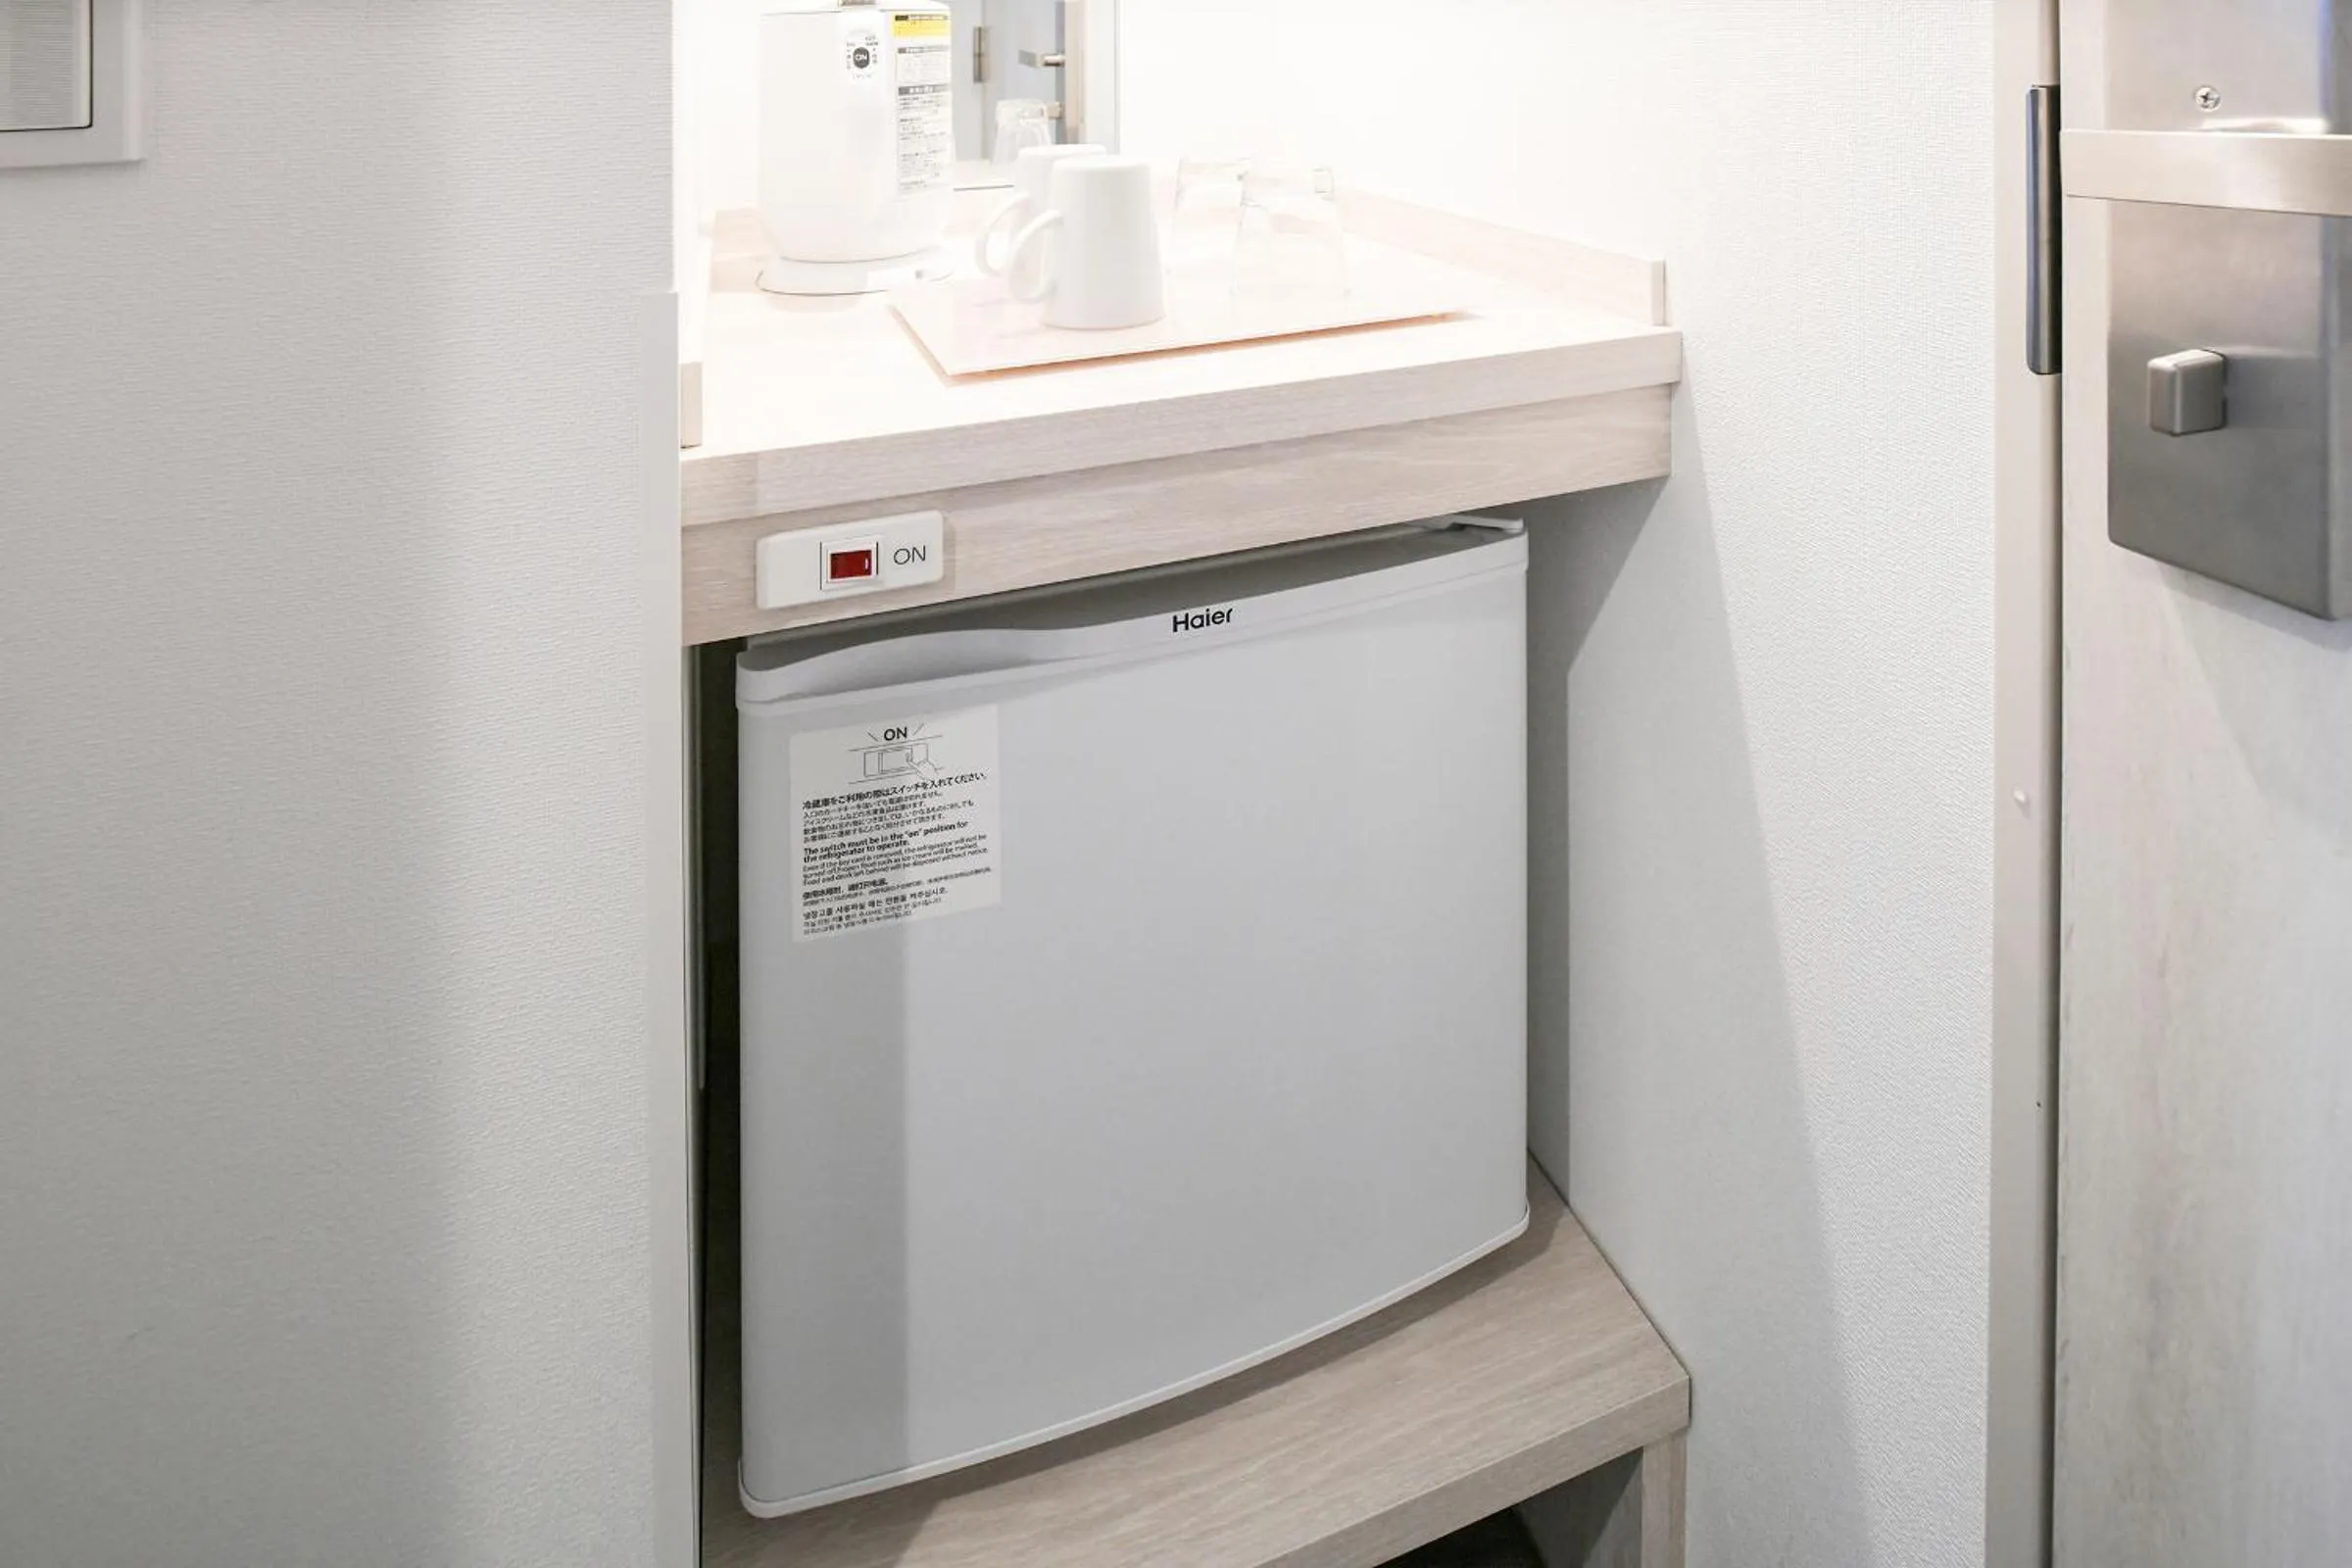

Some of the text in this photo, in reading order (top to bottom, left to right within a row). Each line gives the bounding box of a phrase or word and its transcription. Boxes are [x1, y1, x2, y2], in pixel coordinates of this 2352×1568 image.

[893, 545, 926, 564] ON
[1172, 608, 1233, 633] Haier
[884, 726, 907, 741] ON
[804, 846, 818, 857] The
[819, 842, 845, 854] switch
[847, 838, 868, 849] must
[868, 836, 879, 845] be
[890, 831, 904, 841] the
[922, 822, 955, 835] position
[956, 820, 968, 829] for
[802, 855, 816, 863] the
[817, 847, 864, 861] refrigerator
[875, 839, 909, 851] operate.
